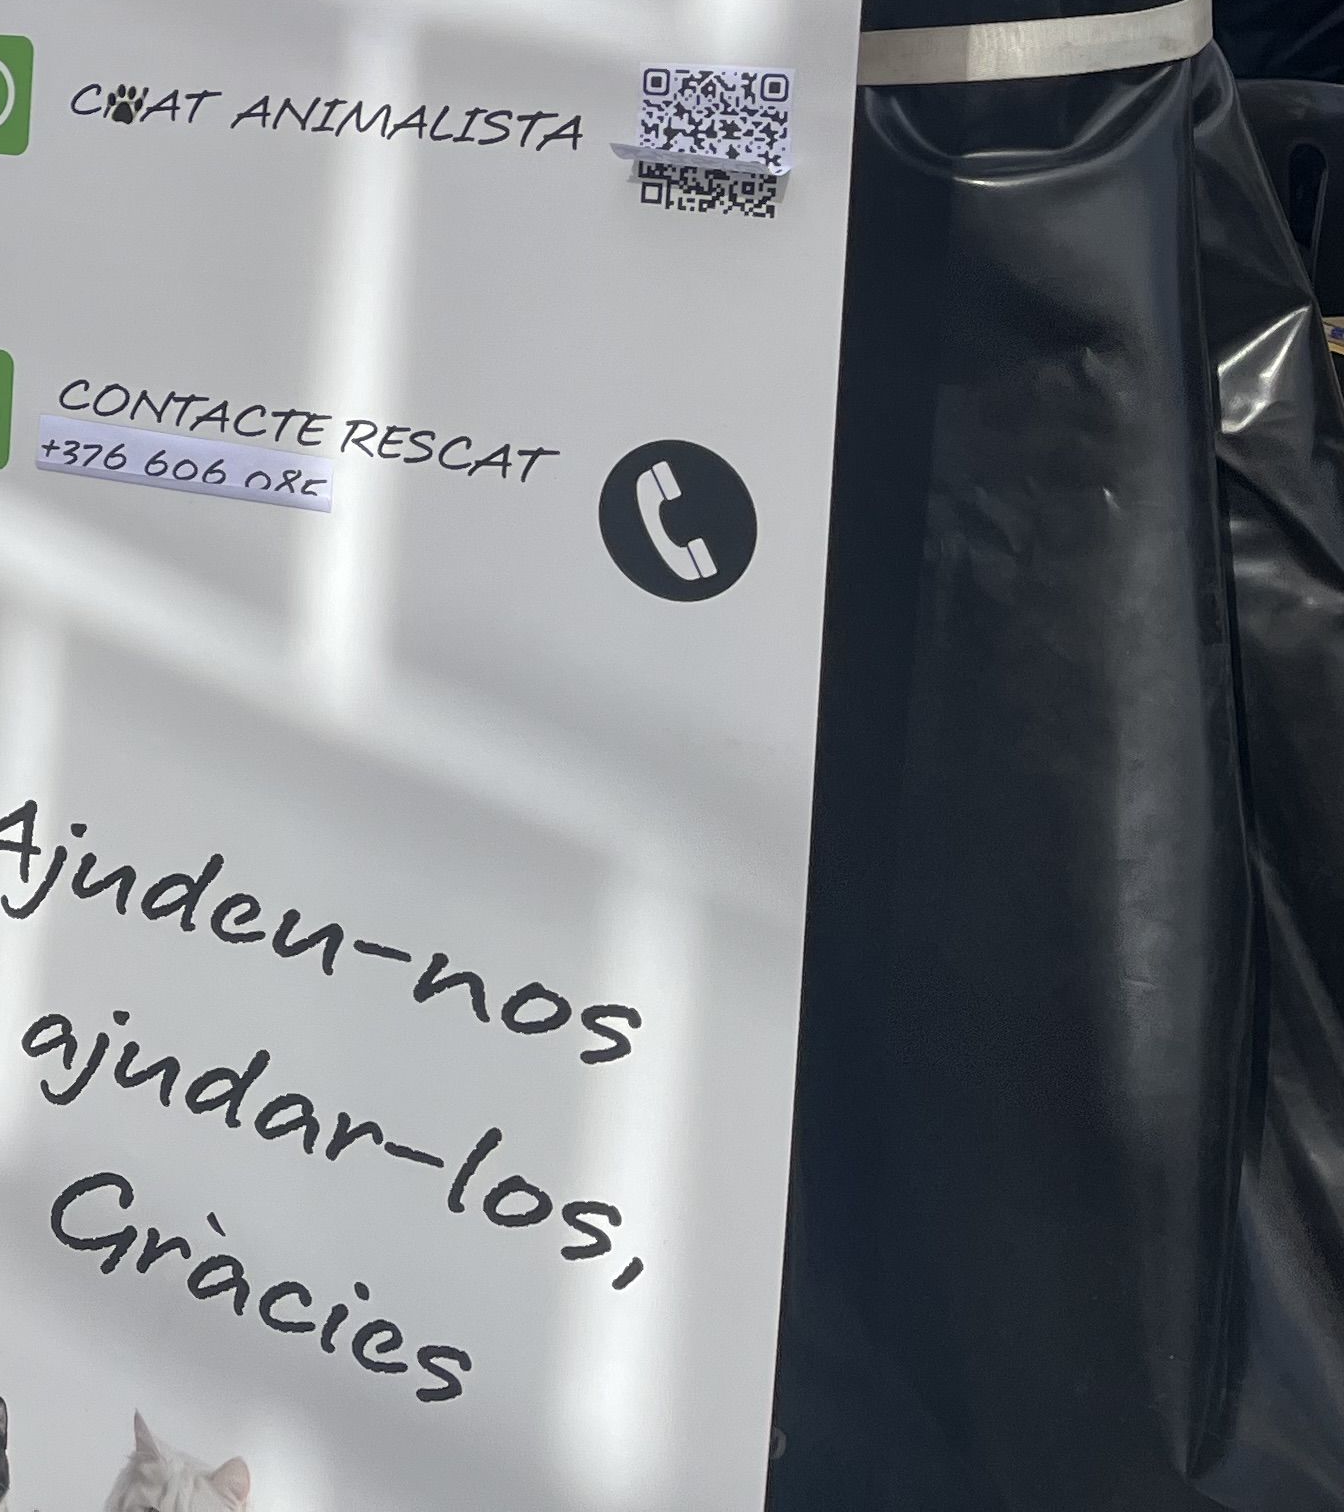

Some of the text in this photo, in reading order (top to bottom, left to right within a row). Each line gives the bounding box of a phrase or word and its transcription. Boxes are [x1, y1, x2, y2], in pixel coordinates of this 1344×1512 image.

[231, 96, 585, 151] ANIMALISTA
[40, 439, 127, 470] +376
[144, 449, 227, 485] 606
[57, 379, 561, 484] CONTACTE RESCAT
[21, 1010, 646, 1290] ajudar-los,
[50, 1172, 473, 1403] Gràcies
